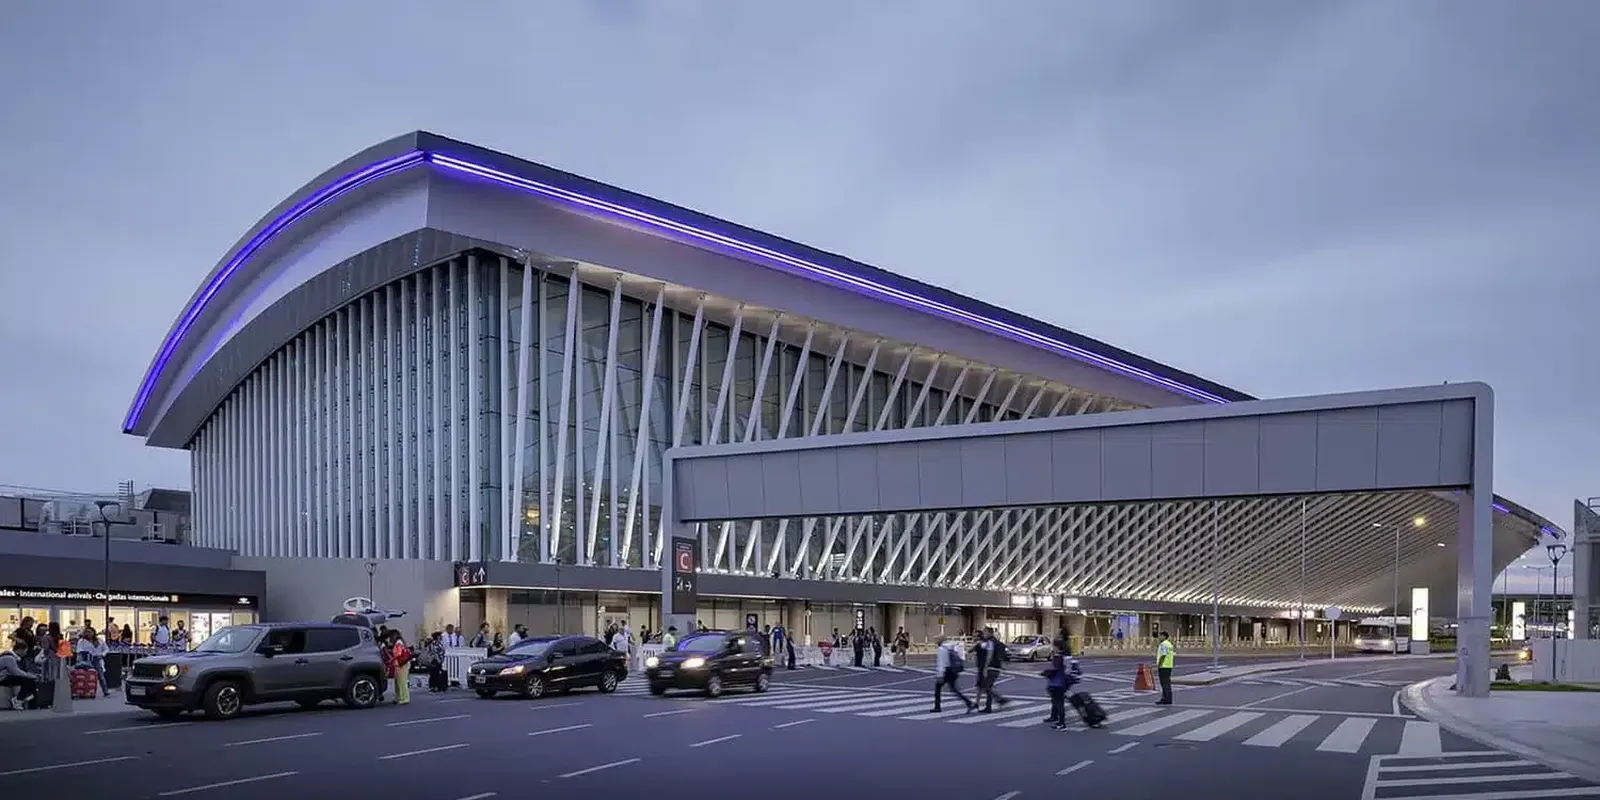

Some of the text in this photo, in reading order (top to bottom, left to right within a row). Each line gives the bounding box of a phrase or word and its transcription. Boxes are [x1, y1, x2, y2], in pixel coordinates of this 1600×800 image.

[680, 552, 689, 570] C
[20, 590, 66, 598] International
[67, 592, 92, 600] arrivals
